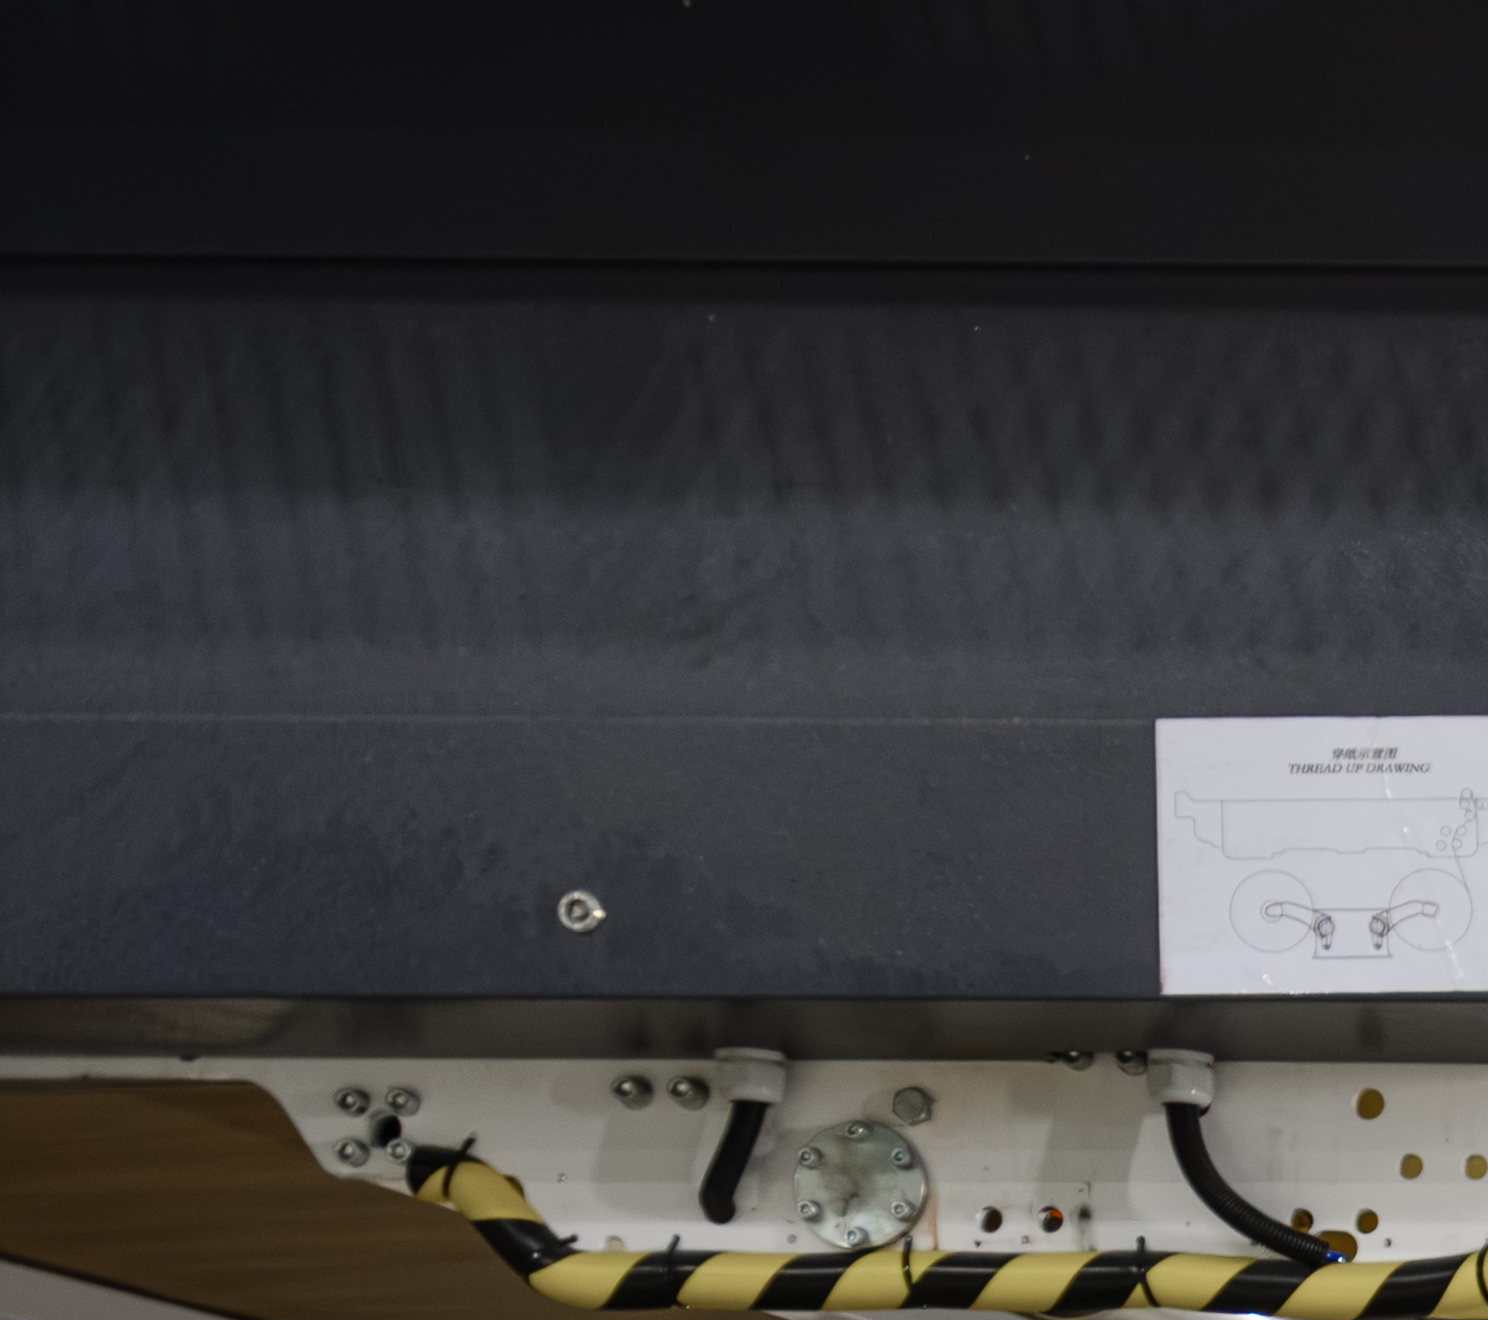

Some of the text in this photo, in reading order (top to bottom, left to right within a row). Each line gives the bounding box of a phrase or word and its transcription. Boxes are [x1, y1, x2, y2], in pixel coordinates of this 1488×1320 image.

[1288, 763, 1430, 774] THREAD UP DRAWING
